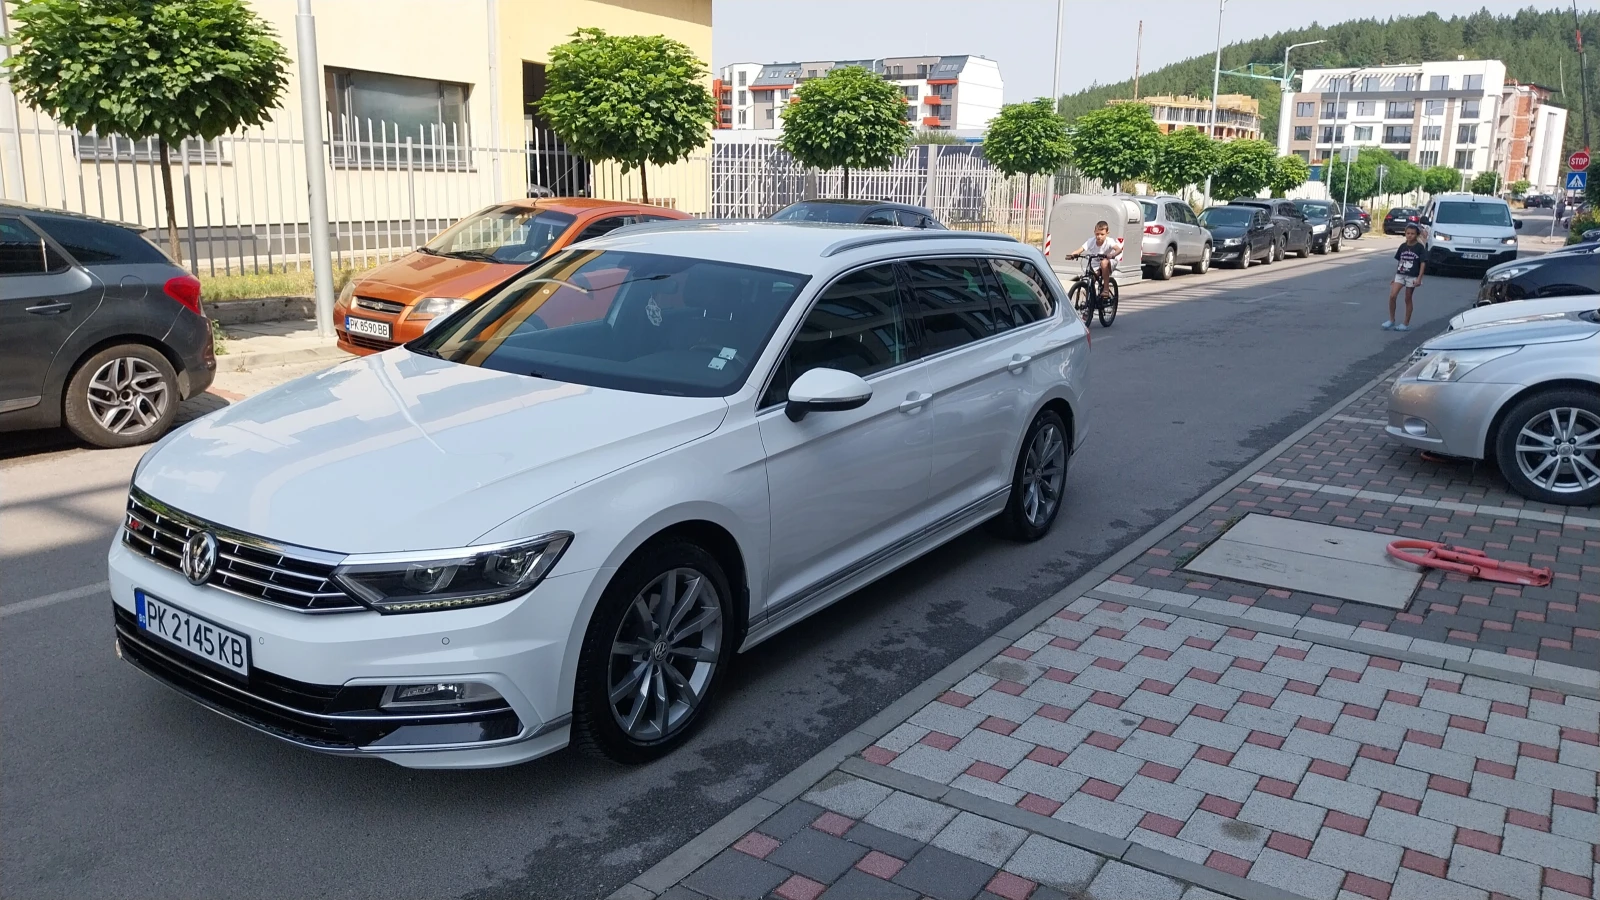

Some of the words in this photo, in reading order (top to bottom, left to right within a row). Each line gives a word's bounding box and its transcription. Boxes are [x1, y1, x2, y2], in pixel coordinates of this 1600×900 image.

[1570, 157, 1588, 165] STOP
[350, 319, 359, 330] PK
[360, 321, 377, 333] 8590
[378, 324, 388, 335] BB
[147, 600, 168, 636] PK
[171, 613, 215, 656] 2145
[218, 631, 244, 668] KB
